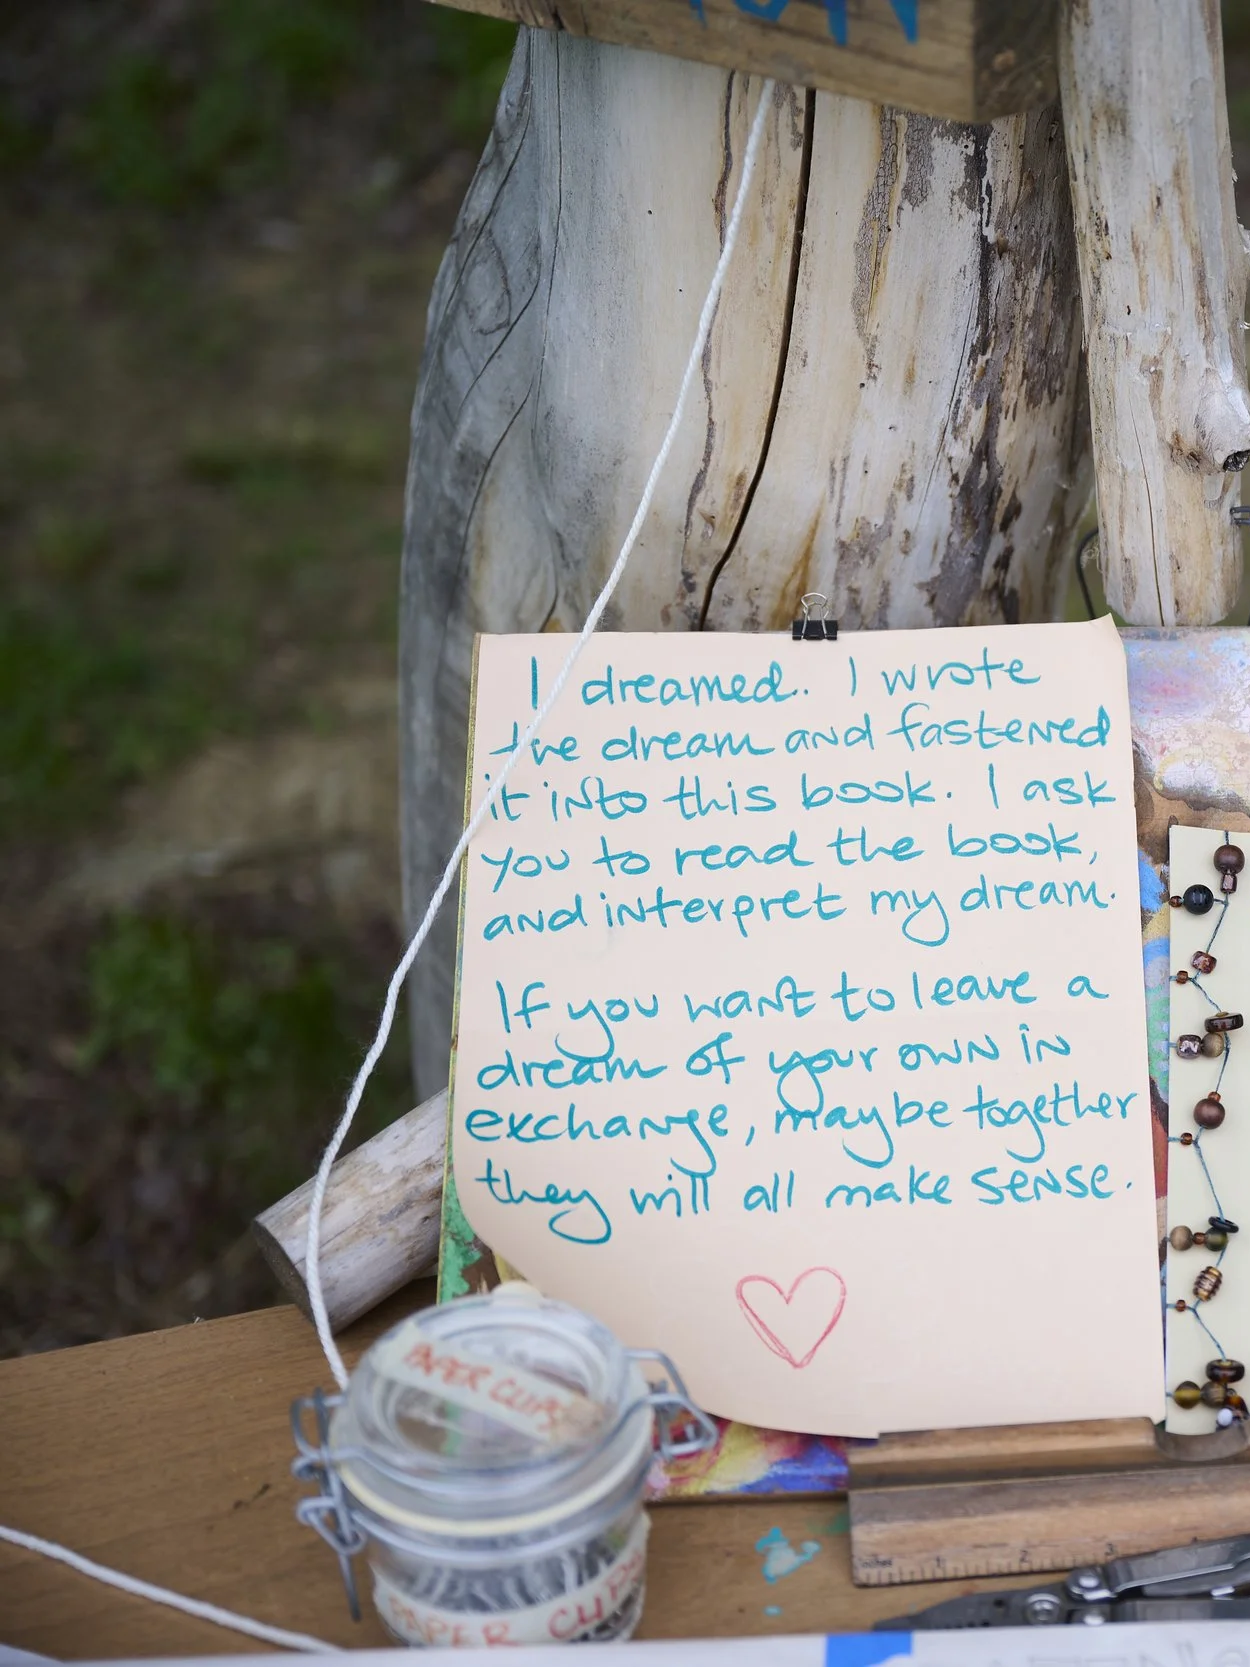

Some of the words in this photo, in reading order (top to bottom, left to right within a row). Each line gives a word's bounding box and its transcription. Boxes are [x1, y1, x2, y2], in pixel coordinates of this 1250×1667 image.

[531, 656, 539, 710] I
[849, 657, 857, 695] I
[881, 648, 1041, 696] wrote
[601, 725, 774, 762] dream
[785, 712, 874, 754] and
[886, 702, 1111, 752] fastened
[484, 773, 530, 821] it
[543, 776, 649, 821] into
[664, 775, 778, 821] this
[801, 770, 953, 811] book.
[988, 763, 999, 809] I
[1023, 771, 1117, 808] ask
[481, 848, 571, 893] you
[592, 835, 651, 877] to
[675, 831, 814, 876] read
[828, 826, 925, 867] the
[948, 822, 1099, 866] book,
[482, 894, 588, 941] and
[602, 886, 847, 939] interpret
[870, 889, 952, 948] my
[960, 878, 1118, 913] dream.
[496, 979, 553, 1034] If
[554, 993, 660, 1060] you
[684, 975, 817, 1023] want
[831, 970, 896, 1023] to
[912, 971, 1038, 1009] leave
[1067, 974, 1110, 1000] a
[477, 1048, 668, 1090] dream
[686, 1031, 746, 1085] of
[767, 1050, 880, 1115] your
[898, 1039, 1001, 1073] own
[1020, 1022, 1072, 1065] in
[464, 1102, 756, 1177] exchange,
[774, 1084, 953, 1170] maybe
[963, 1080, 1138, 1164] together
[475, 1158, 613, 1246] they
[629, 1170, 711, 1219] will
[743, 1170, 796, 1213] all
[825, 1165, 953, 1210] make
[970, 1163, 1136, 1206] sense.
[1019, 1549, 1029, 1563] 2
[1105, 1541, 1115, 1556] 3
